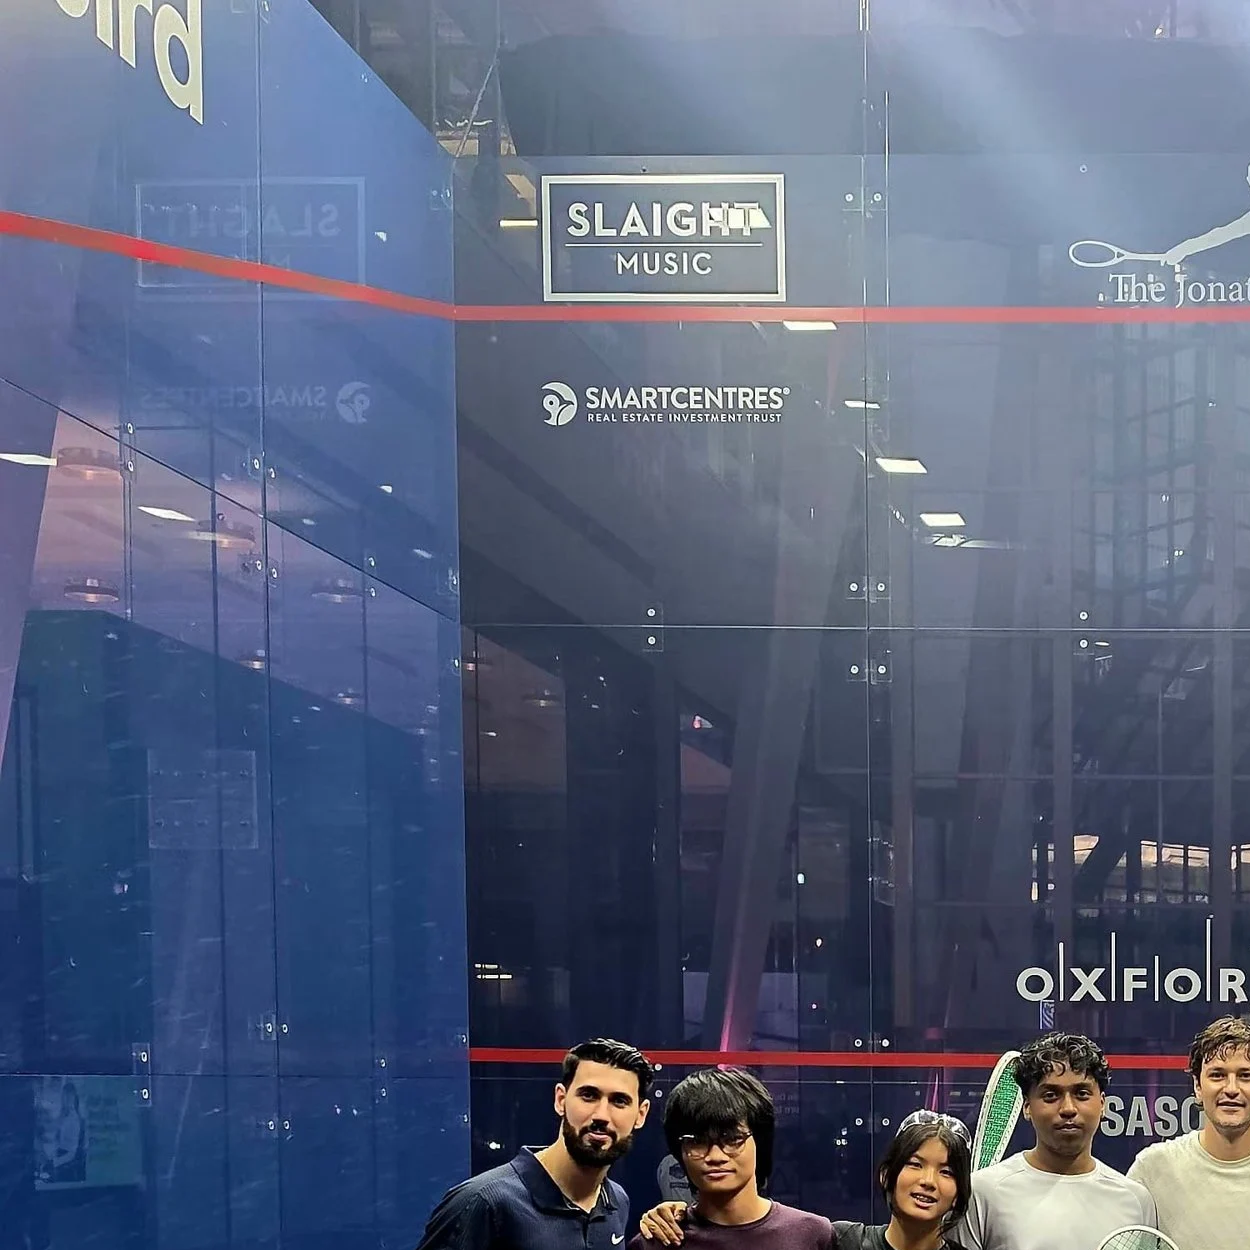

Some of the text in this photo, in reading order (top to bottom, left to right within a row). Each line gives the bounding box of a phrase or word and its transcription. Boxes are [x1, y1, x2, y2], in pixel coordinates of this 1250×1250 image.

[55, 0, 204, 125] ird
[566, 201, 760, 237] SLAIGHT
[616, 251, 713, 275] MUSIC
[1108, 272, 1166, 302] The
[586, 413, 782, 423] REAL ESTATE INVESTMENT TRUST
